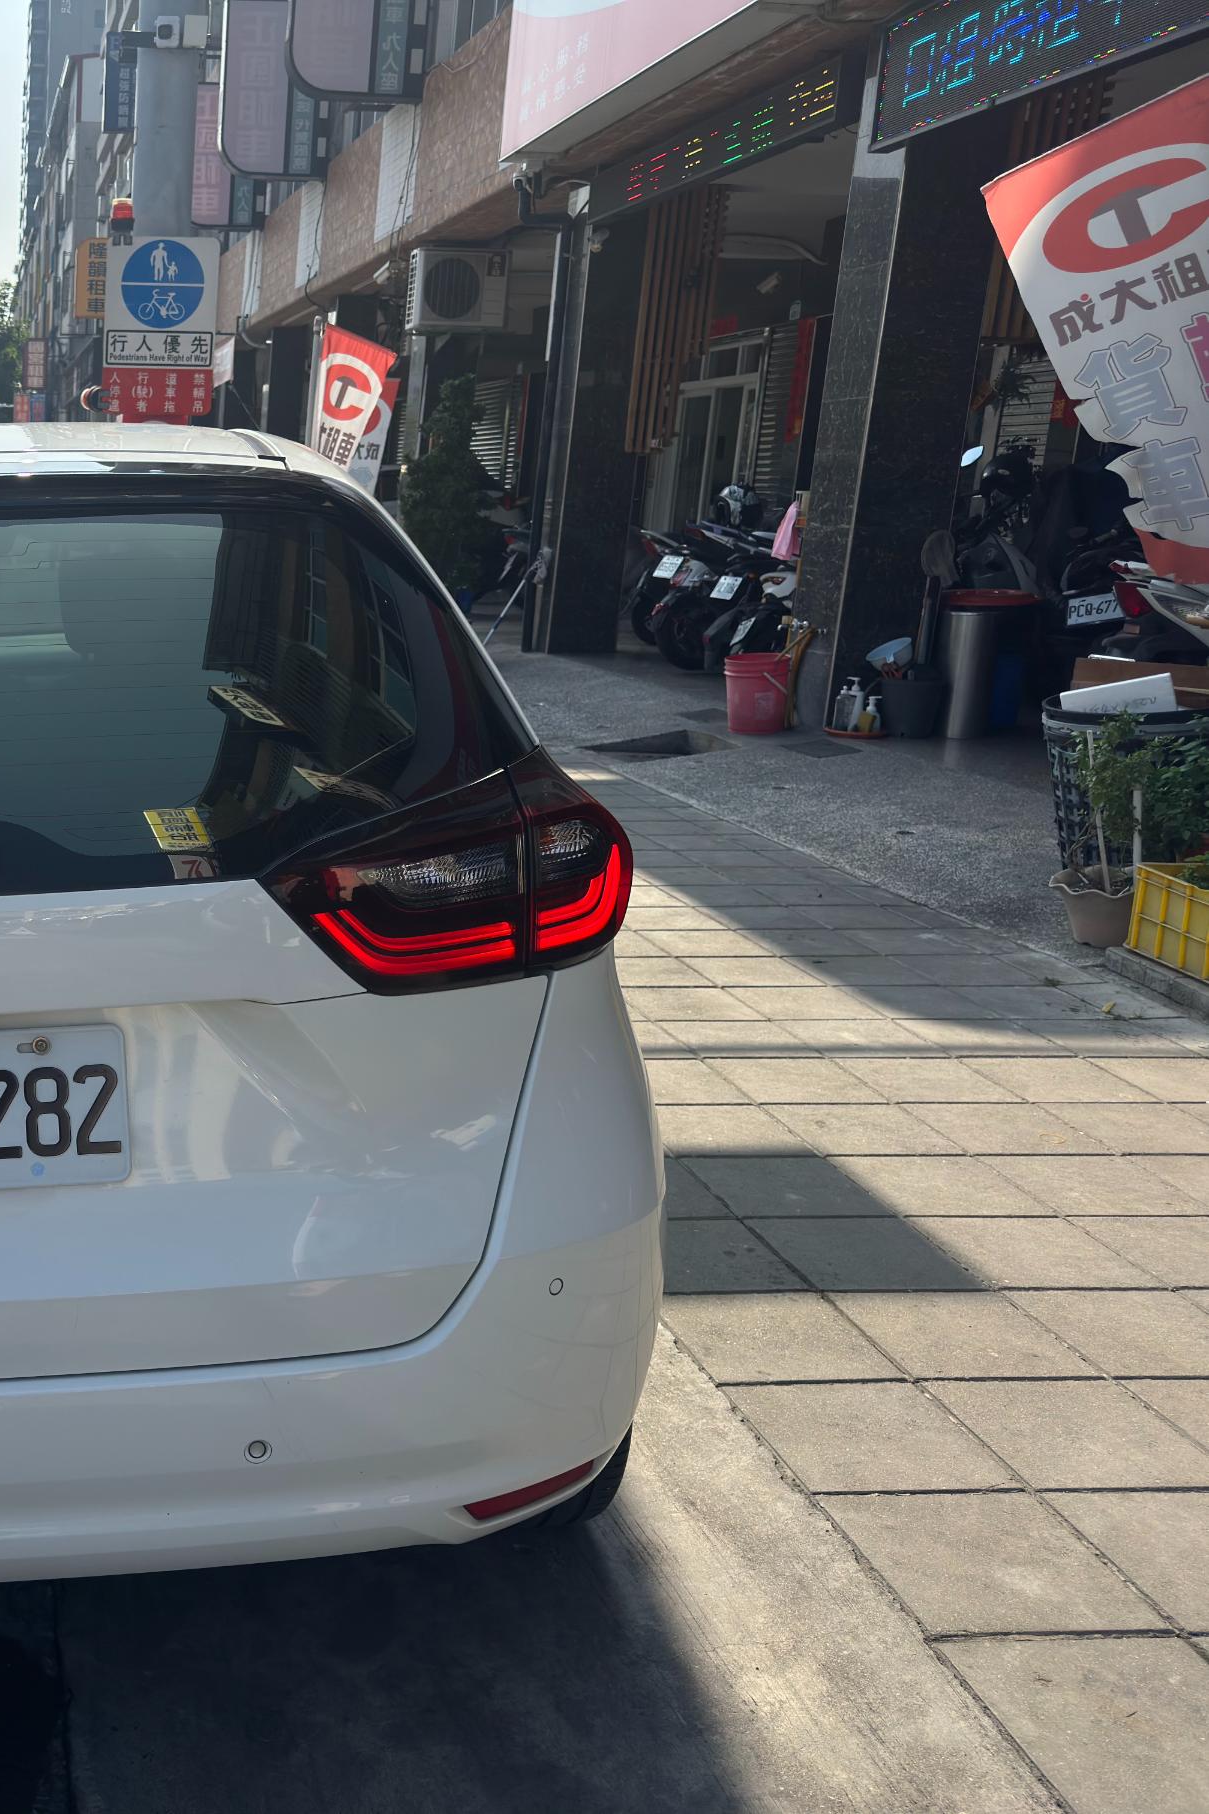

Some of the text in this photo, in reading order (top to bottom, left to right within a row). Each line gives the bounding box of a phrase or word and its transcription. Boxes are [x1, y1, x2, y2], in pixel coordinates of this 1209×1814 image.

[1049, 251, 1209, 347] 成大租
[110, 334, 208, 354] 行人優先
[110, 353, 147, 361] Pedestrians
[167, 354, 184, 363] Right
[194, 355, 208, 364] Way
